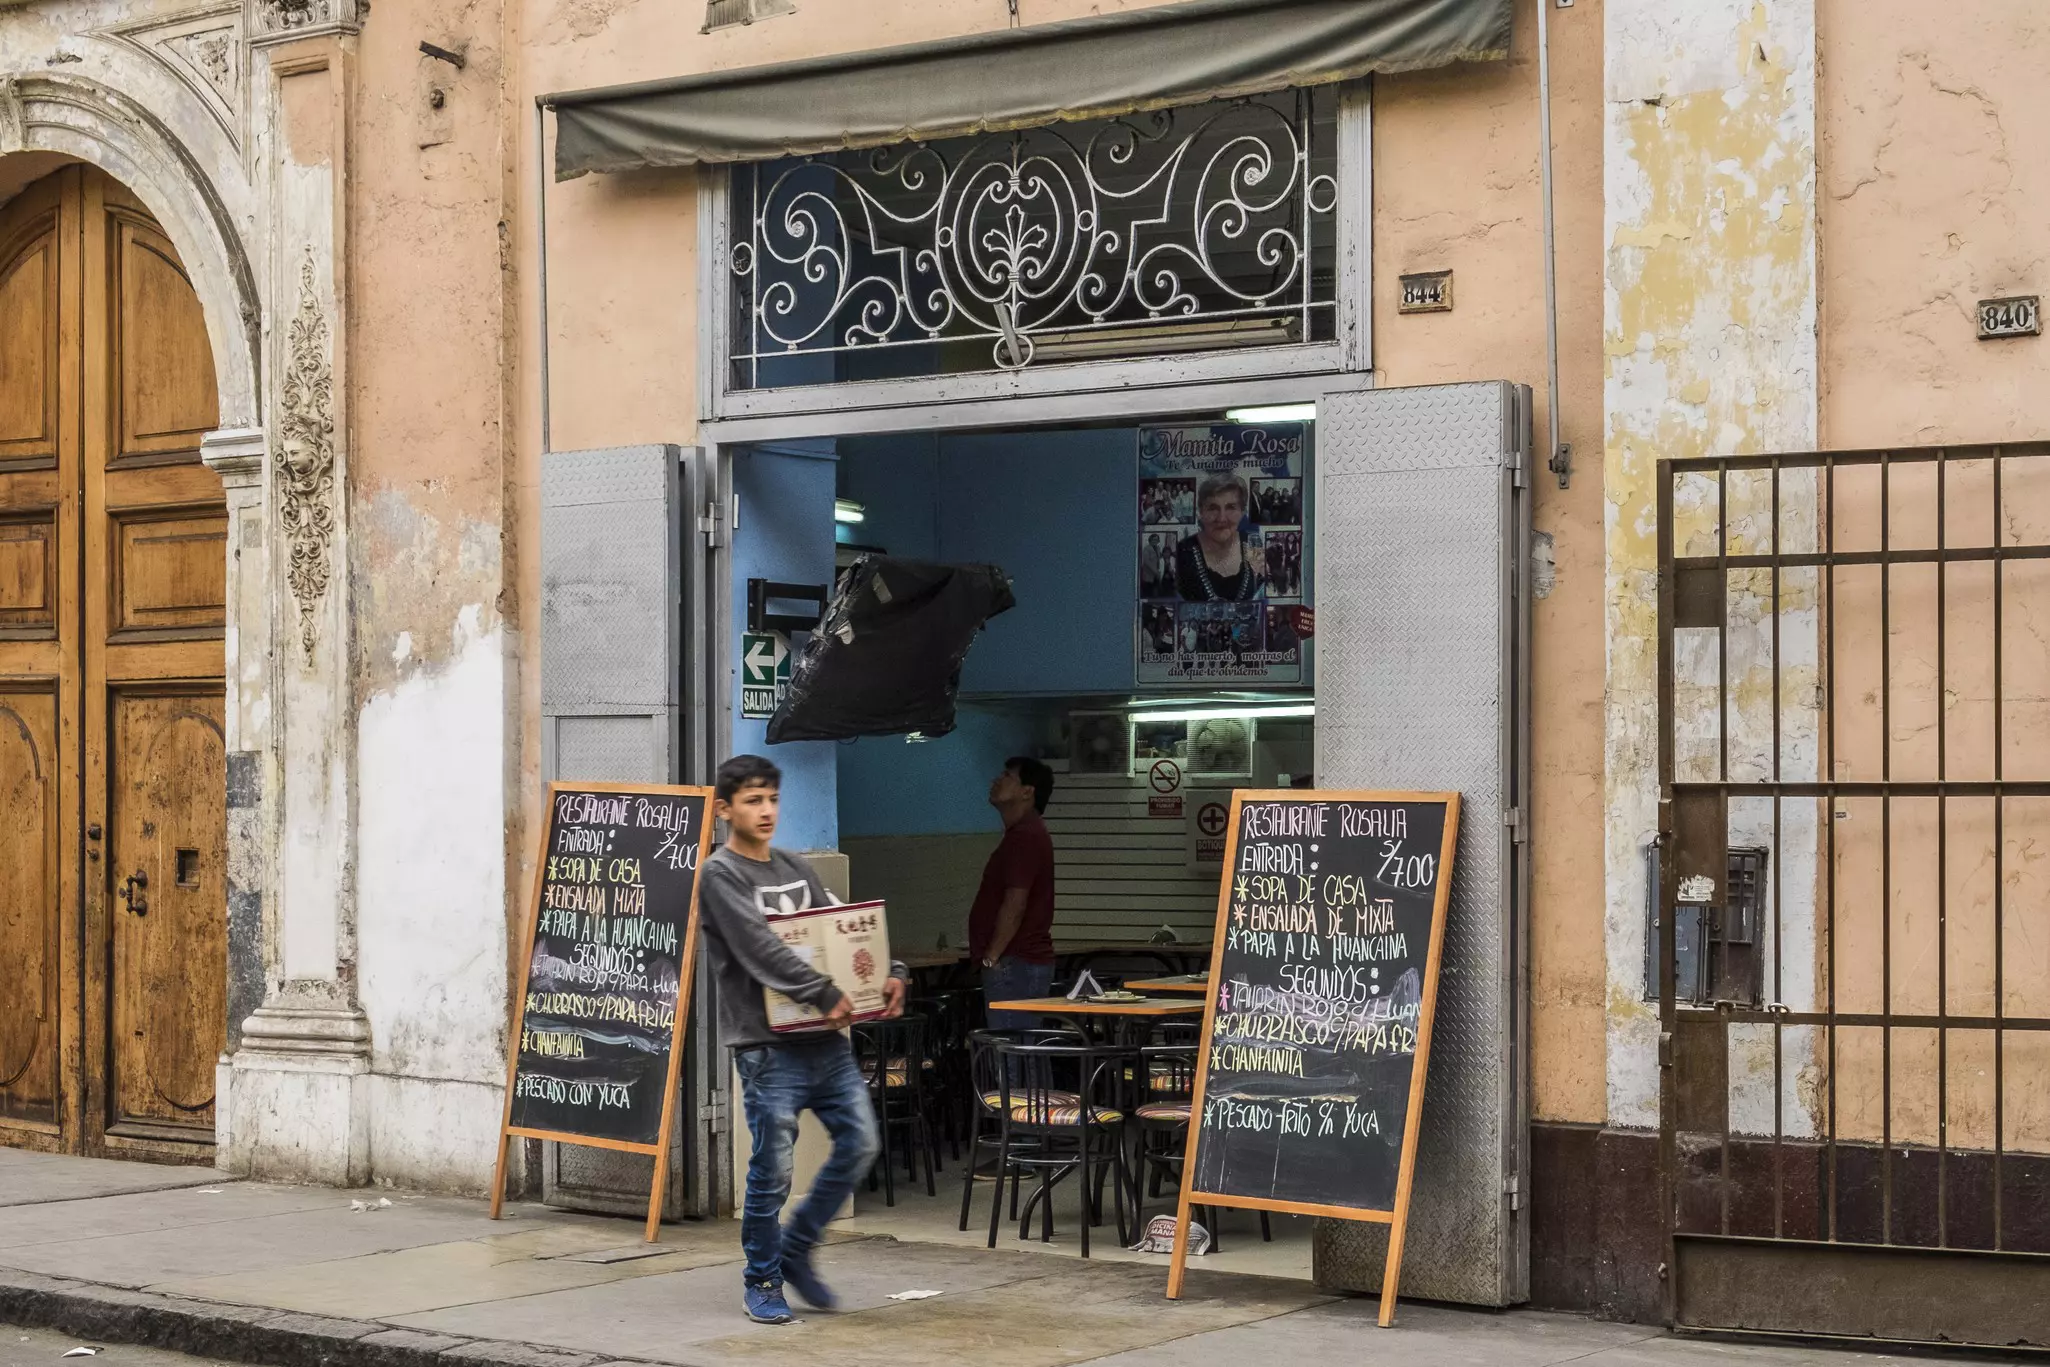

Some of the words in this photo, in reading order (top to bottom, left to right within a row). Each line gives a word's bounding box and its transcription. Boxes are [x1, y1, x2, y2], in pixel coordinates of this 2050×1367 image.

[1404, 283, 1441, 303] 844
[1985, 304, 2030, 330] 840
[1141, 428, 1235, 459] Mamita
[1240, 429, 1301, 456] Rosa
[1187, 458, 1239, 470] Amamos
[1243, 456, 1284, 469] mucho
[1143, 650, 1160, 662] Tu
[1162, 652, 1174, 662] no
[1176, 648, 1195, 662] has
[1284, 648, 1296, 661] el
[1186, 668, 1204, 679] que
[1218, 664, 1269, 677] olvidemos
[744, 690, 774, 711] SALIDA
[556, 794, 632, 826] RESTAURANTE
[636, 798, 689, 835] ROSALIA
[1242, 803, 1330, 839] RESTAURANTE
[1338, 804, 1407, 838] ROSALIA
[559, 857, 585, 883] SOPA
[587, 858, 603, 884] DE
[609, 858, 641, 884] CASA
[555, 885, 606, 914] ENSALADA
[613, 883, 646, 915] MIXTA
[1251, 876, 1287, 903] SOPA
[1296, 875, 1316, 904] DE
[1323, 875, 1367, 906] CASA
[552, 910, 577, 939] PAPA
[581, 916, 590, 942] A
[594, 914, 607, 943] LA
[611, 916, 678, 956] HUANCAINA
[1250, 904, 1318, 935] ENSALADA
[1325, 906, 1347, 939] DE
[1356, 898, 1394, 936] MIXTA
[1241, 930, 1276, 958] PAPA
[1285, 933, 1295, 962] A
[1302, 933, 1320, 961] LA
[1333, 933, 1408, 964] HUANCAINA
[535, 992, 596, 1018] CHURRASCO
[1226, 1012, 1329, 1045] CHURRASCO
[523, 1077, 566, 1104] PESCADO
[569, 1082, 592, 1105] CON
[598, 1083, 630, 1110] YUCA
[1217, 1098, 1272, 1132] PESCADO
[1343, 1103, 1379, 1138] YUCA
